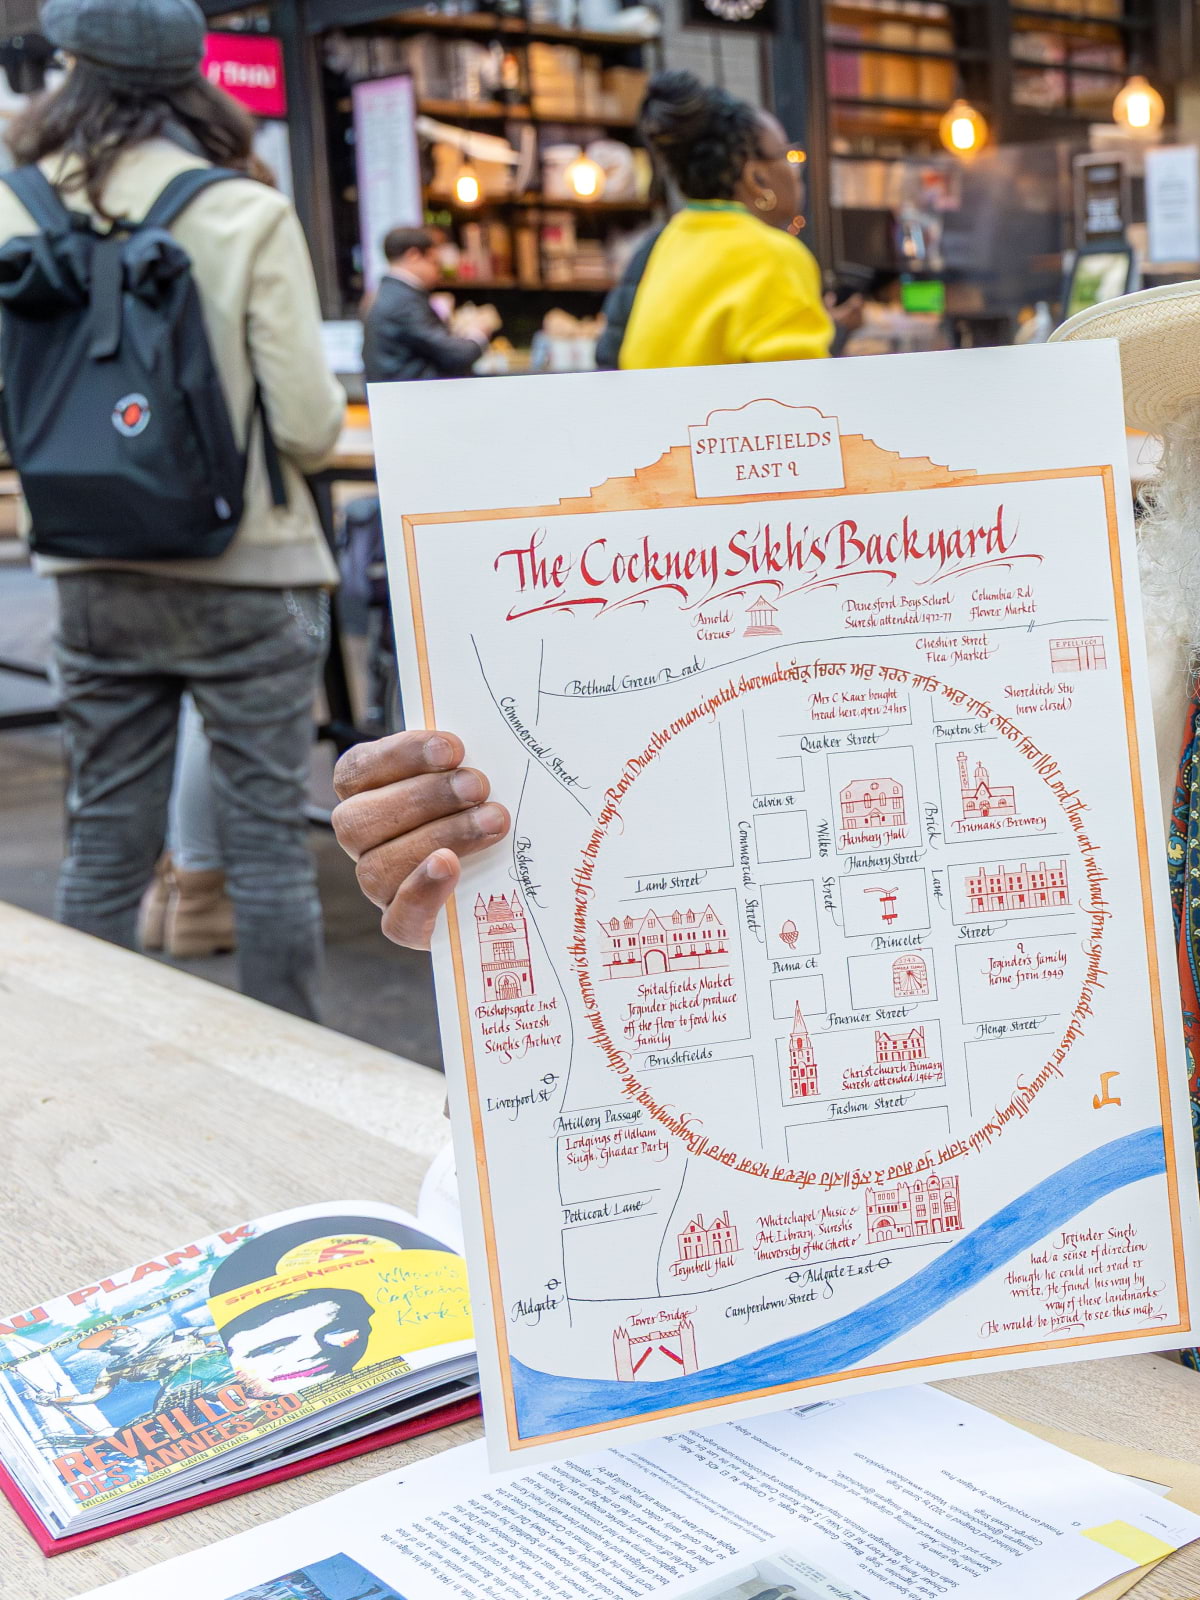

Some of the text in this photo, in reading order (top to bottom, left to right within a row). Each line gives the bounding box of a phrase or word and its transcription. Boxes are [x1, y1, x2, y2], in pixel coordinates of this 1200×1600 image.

[696, 432, 831, 454] SPITALFIELDS
[736, 463, 782, 481] EAST
[494, 504, 1020, 602] The Cockney Sikh's Backyard
[900, 597, 922, 611] Boys
[922, 592, 954, 606] School
[972, 585, 1033, 601] Columbia Rd
[691, 611, 734, 626] Arnold
[844, 611, 952, 629] Suresh attended 1972-77
[970, 602, 1038, 621] Flower Market
[697, 628, 735, 640] Circus
[916, 633, 989, 649] Cheshire Street
[926, 648, 996, 667] Flea Market
[564, 655, 706, 696] Bethnal Green Road
[842, 689, 898, 703] Kaur bought
[1004, 683, 1056, 700] Shoreditch
[811, 706, 880, 720] bread open
[500, 697, 551, 759] Commercial
[933, 724, 972, 738] Buxton
[800, 730, 884, 753] Quaker Street
[752, 798, 784, 809] Calvin
[924, 802, 942, 849] Brick
[951, 816, 1047, 833] Truman's Brewery
[816, 819, 832, 857] Wilkes
[838, 833, 882, 850] Hanbury
[738, 820, 757, 891] Commercial
[844, 851, 926, 874] Hanbury Street
[635, 872, 707, 893] Lamb Street
[1083, 856, 1109, 907] without
[872, 924, 1001, 950] Princelet Street
[1031, 950, 1068, 970] family
[638, 974, 735, 1000] Spitalfields Market
[988, 969, 1064, 989] home from 1949
[475, 997, 559, 1020] Bishopsgate Inst
[621, 992, 737, 1021] Joginder picked produce
[481, 1015, 550, 1036] holds Suresh
[639, 1011, 727, 1032] the feed his
[821, 1005, 914, 1030] Fournier Street
[1010, 1017, 1043, 1032] Street
[519, 1034, 562, 1059] Archive
[633, 1034, 671, 1050] family
[644, 1047, 712, 1070] Brushfields
[873, 1074, 914, 1087] attended
[487, 1089, 536, 1121] Liverpool
[827, 1094, 913, 1119] Fashion Street
[550, 1109, 643, 1138] Artillery Passage
[566, 1127, 657, 1152] Lodgings of Udham
[598, 1139, 669, 1168] Ghadar Party
[562, 1197, 651, 1224] Petticoat Lane
[757, 1206, 847, 1227] Whitechapel Music
[1053, 1223, 1137, 1250] Joginder Singh
[1031, 1243, 1147, 1265] had sense direction
[67, 1224, 257, 1306] PLAN K
[1004, 1258, 1144, 1289] though he could not read or
[800, 1260, 876, 1299] Aldgate East
[511, 1295, 564, 1326] Aldgate
[626, 1306, 697, 1327] Tower Bridge
[725, 1290, 819, 1324] Camperdown Street
[978, 1306, 1131, 1338] He would be proud to see this
[70, 1393, 302, 1501] DES ANNEES 80
[81, 1486, 127, 1510] MICHAEL
[127, 1468, 172, 1492] GALASSO
[180, 1452, 208, 1468] GAVIN
[213, 1434, 249, 1453] BRYARS
[941, 1470, 956, 1480] Press
[929, 1504, 946, 1516] 2023
[986, 1495, 1007, 1506] paper
[1004, 1504, 1031, 1519] recycled
[951, 1517, 981, 1534] Designed
[1039, 1522, 1064, 1536] Printed
[992, 1538, 1023, 1557] Published
